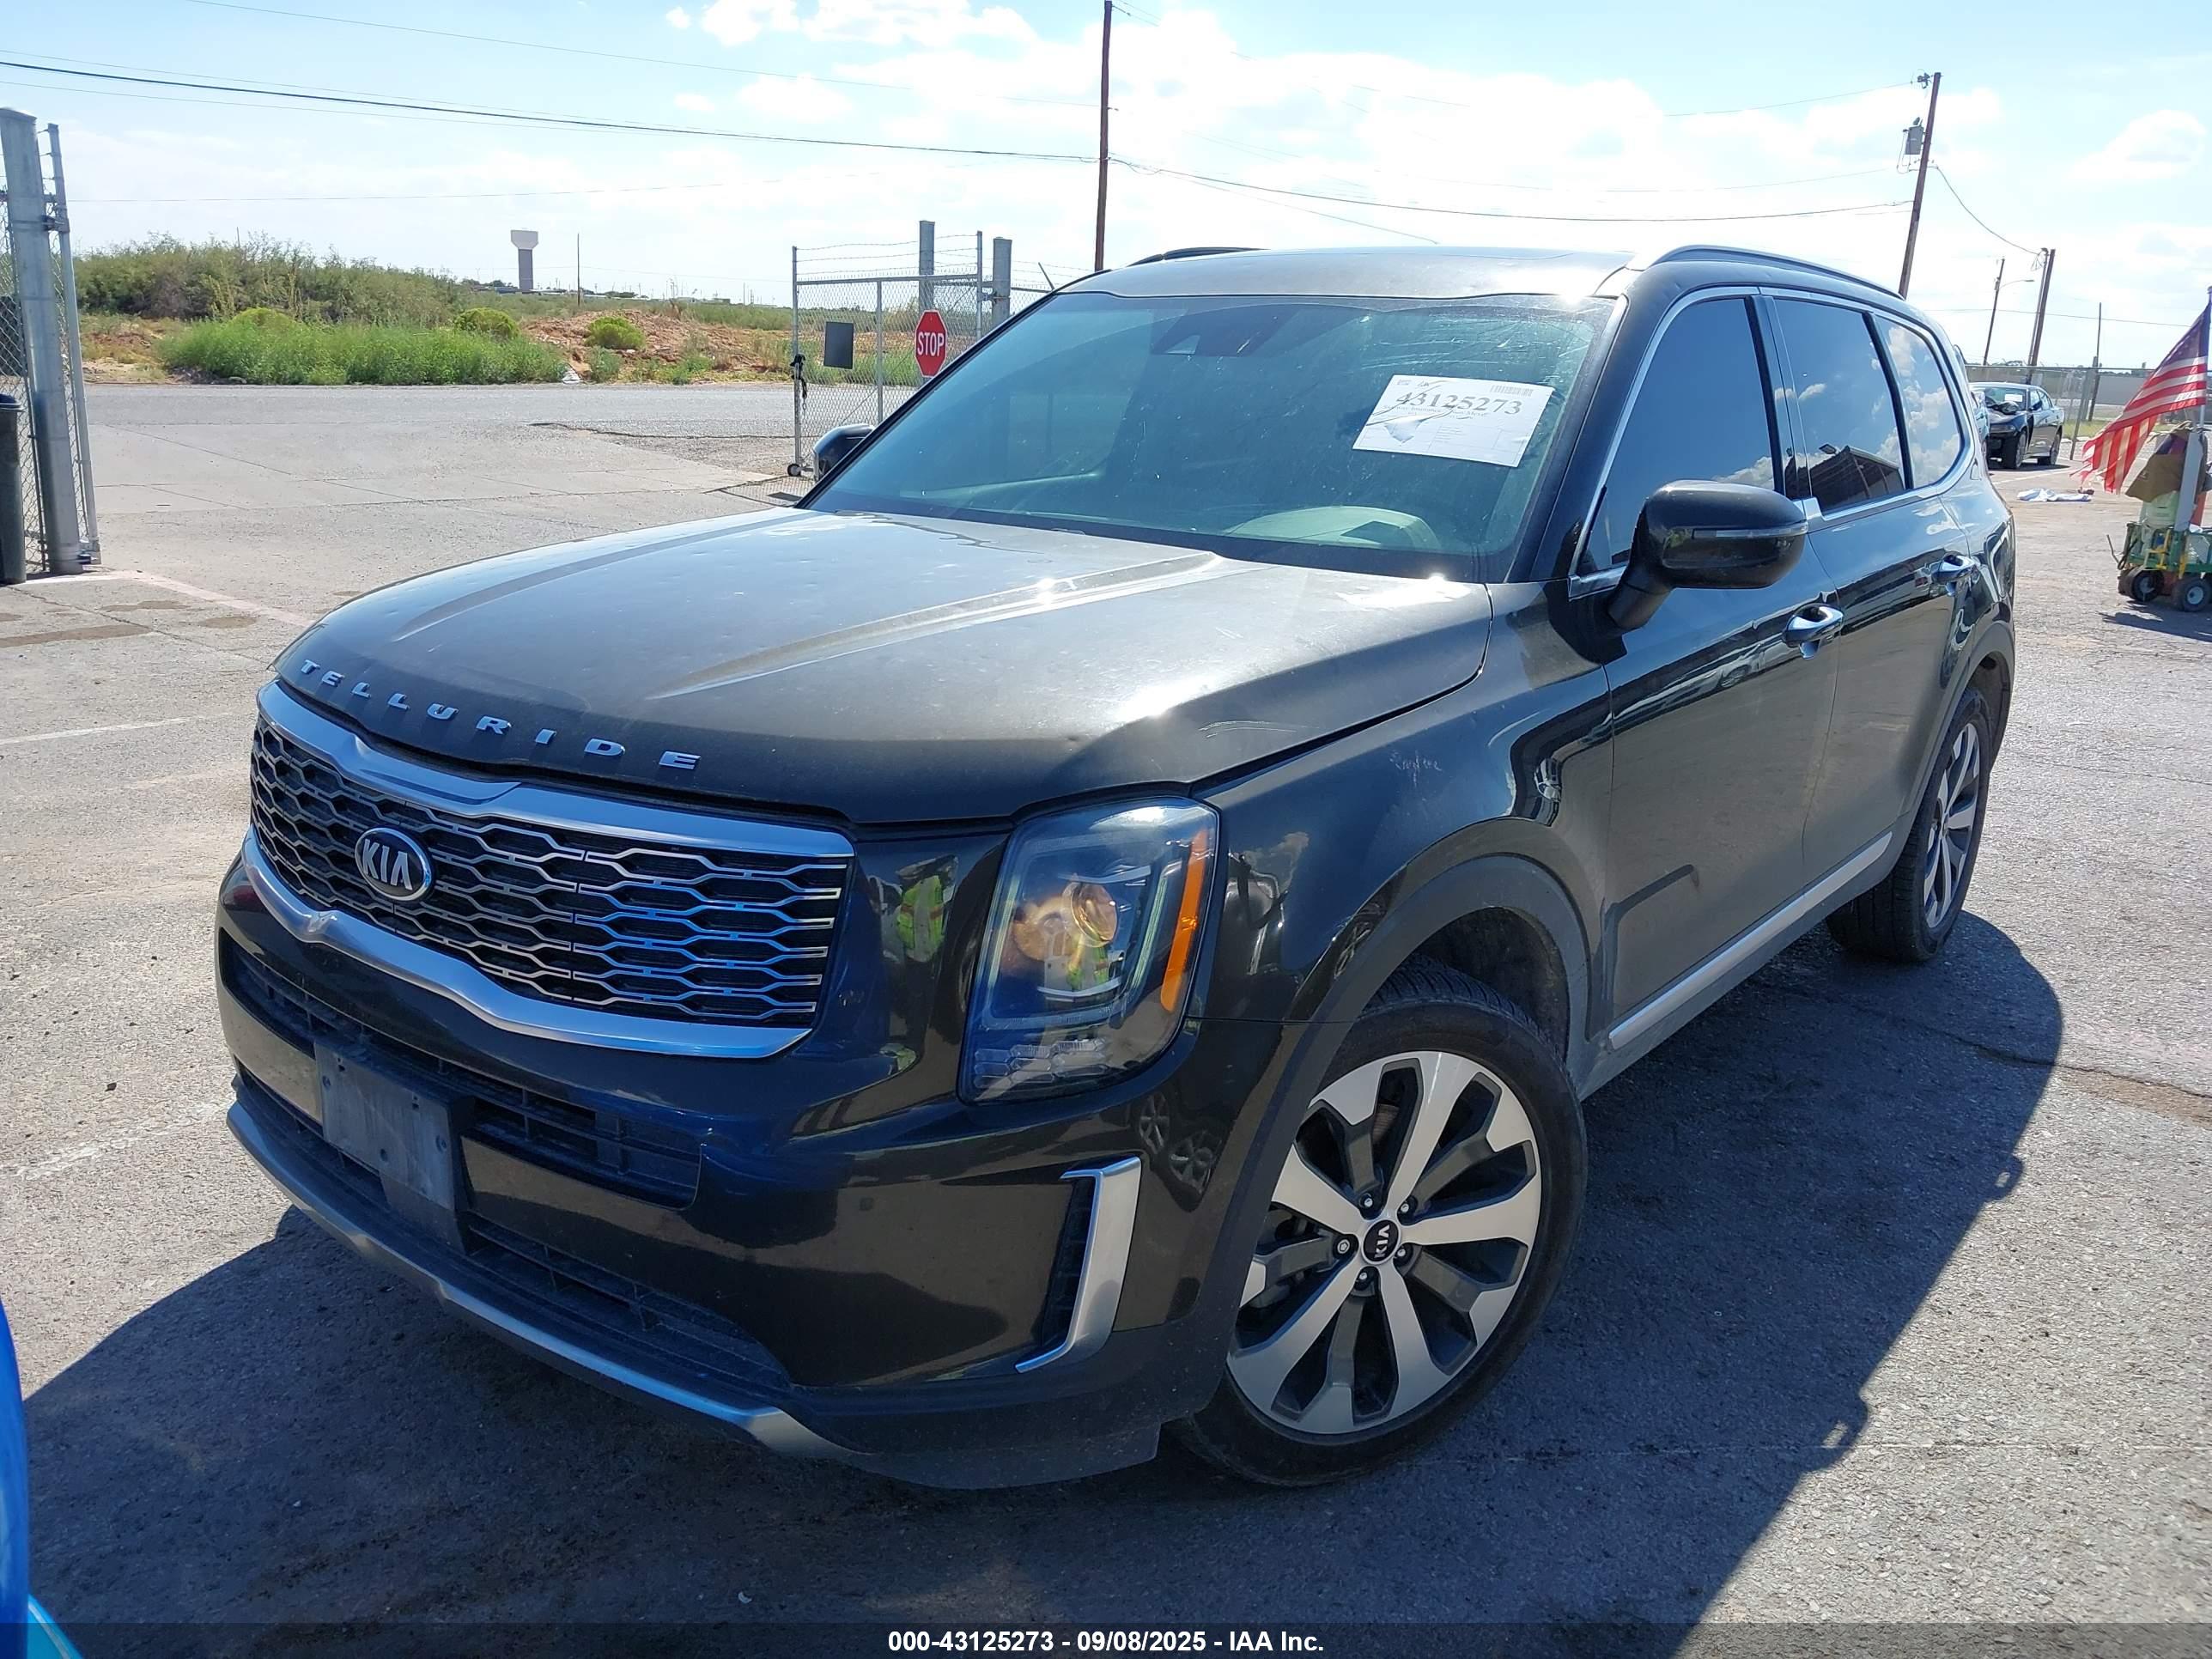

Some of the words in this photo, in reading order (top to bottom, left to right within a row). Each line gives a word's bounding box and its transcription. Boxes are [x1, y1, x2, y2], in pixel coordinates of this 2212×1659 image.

[917, 331, 944, 356] STOP
[1396, 392, 1522, 415] 43125273
[301, 659, 701, 769] TELLURIDE
[362, 838, 413, 890] KIA
[1375, 1224, 1389, 1258] KIA
